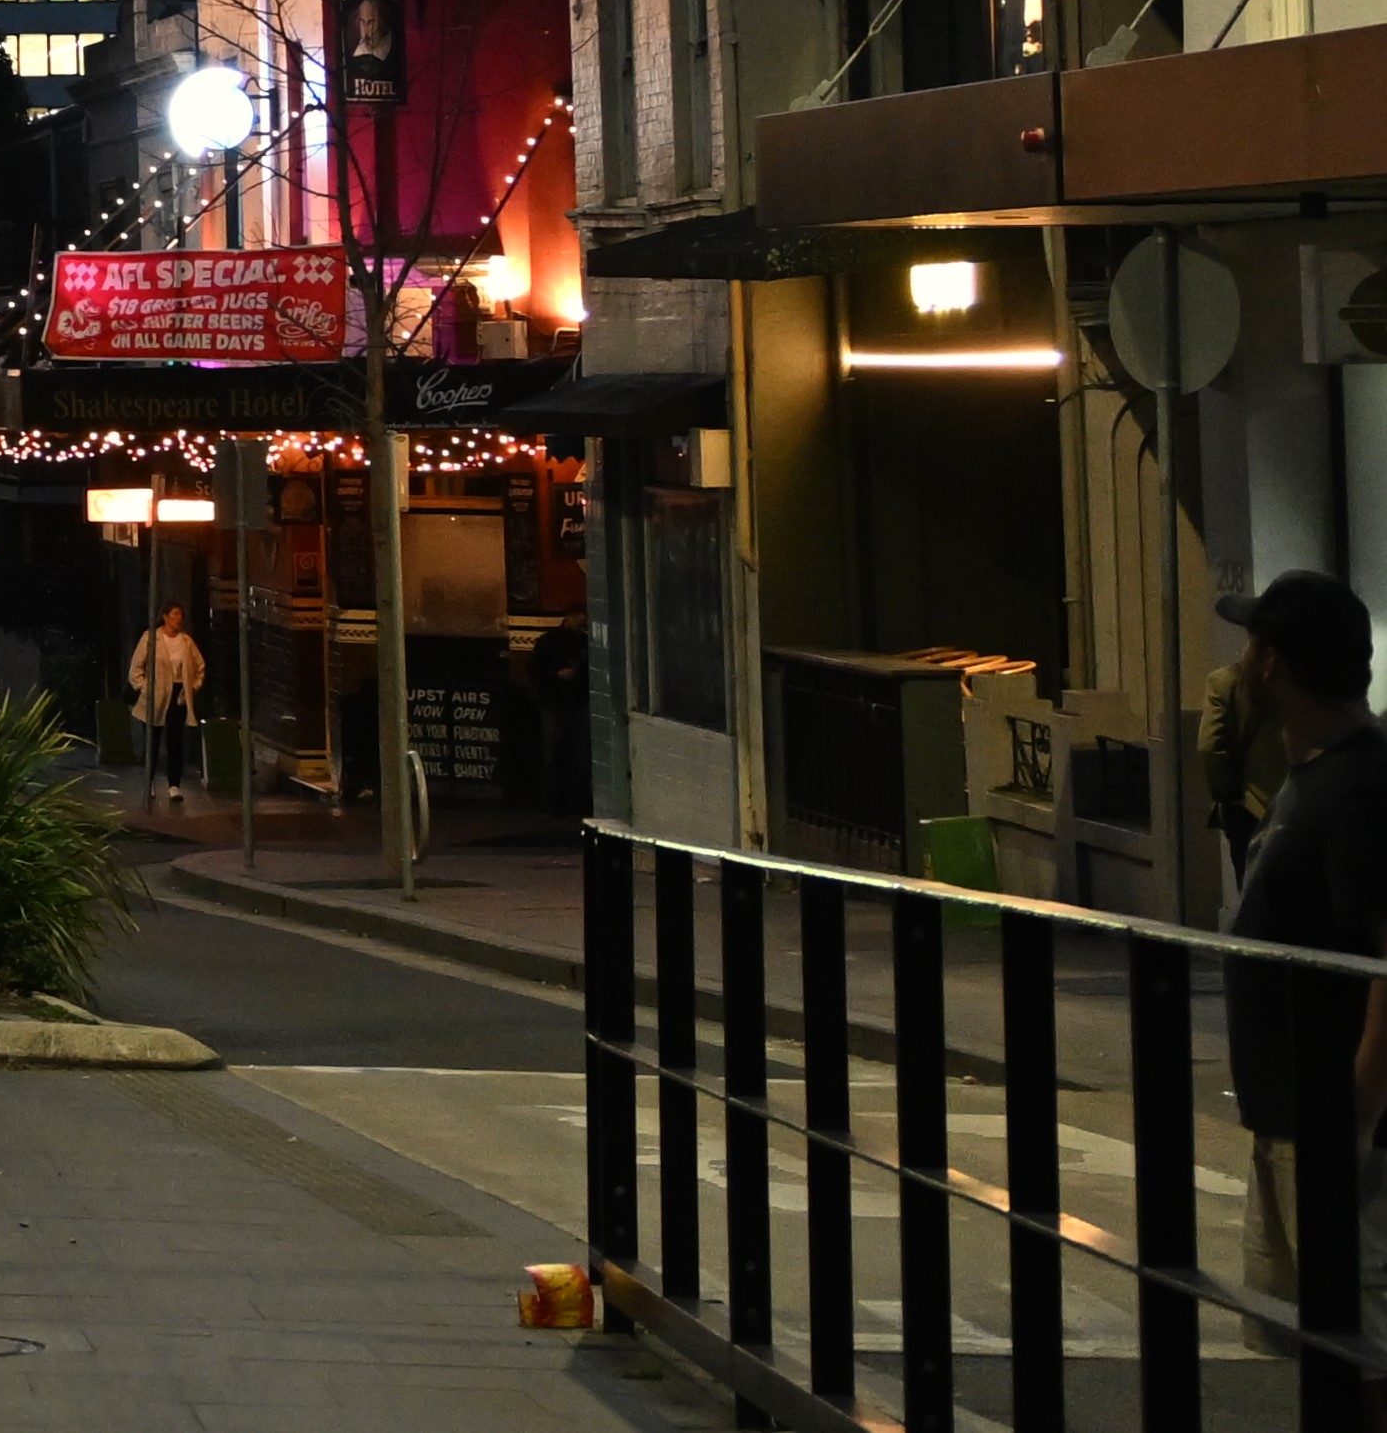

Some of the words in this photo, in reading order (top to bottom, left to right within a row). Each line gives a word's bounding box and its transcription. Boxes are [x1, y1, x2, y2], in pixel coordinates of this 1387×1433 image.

[354, 78, 396, 96] HOTEL
[101, 262, 152, 291] AFL
[156, 258, 287, 288] SPECIAL
[107, 296, 139, 317] $18
[221, 292, 269, 312] JUGS
[208, 313, 265, 331] BEERS
[111, 333, 131, 349] ON
[134, 333, 161, 349] ALL
[163, 333, 212, 349] GAME
[216, 333, 266, 351] DAYS
[416, 368, 493, 414] Coopers
[53, 389, 220, 425] Shakespeare
[228, 387, 305, 418] Hotel
[413, 704, 445, 718] NOW
[453, 706, 487, 722] OPEN
